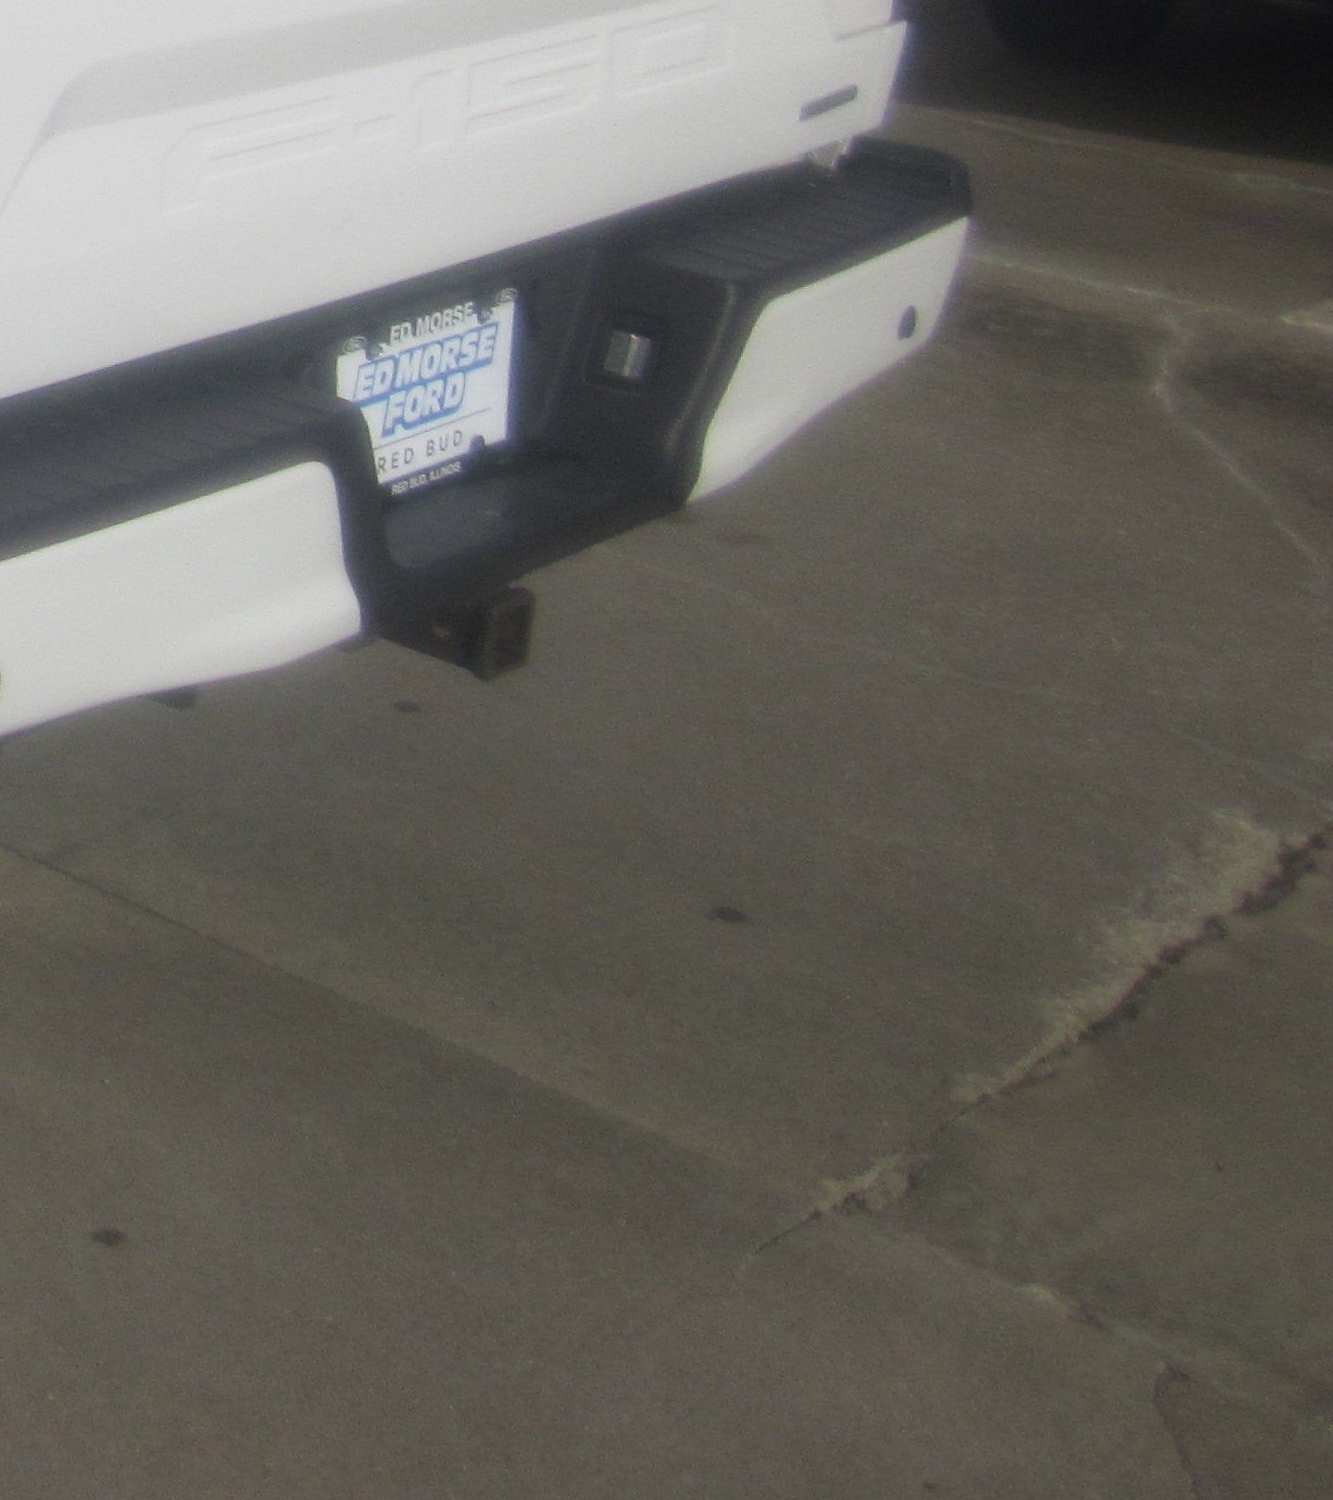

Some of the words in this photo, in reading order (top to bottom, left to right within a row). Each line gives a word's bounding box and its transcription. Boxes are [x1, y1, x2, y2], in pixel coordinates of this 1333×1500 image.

[161, 3, 737, 216] F-150
[416, 302, 474, 337] MORSE
[382, 372, 466, 437] FORD
[377, 448, 414, 473] RED
[426, 430, 463, 457] BUD
